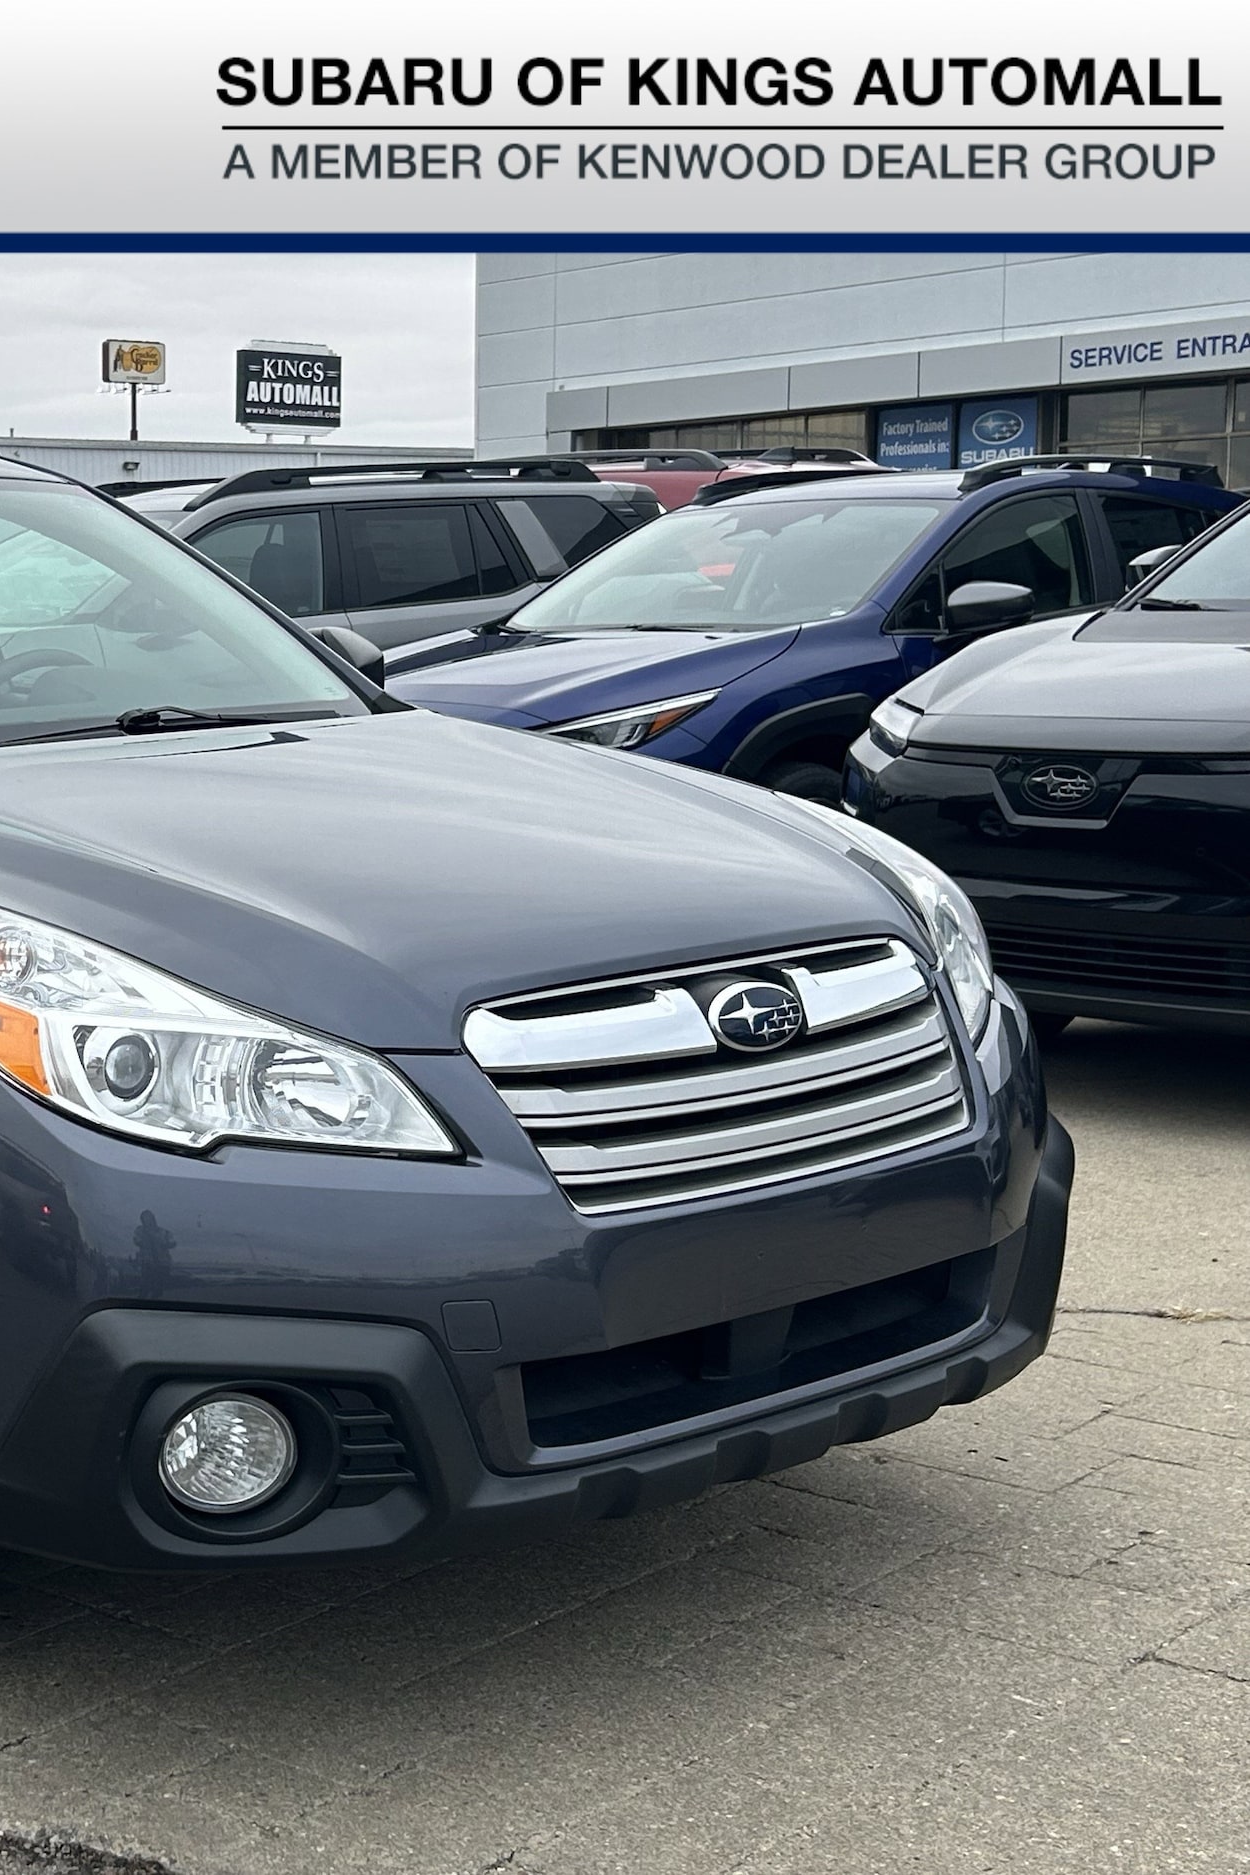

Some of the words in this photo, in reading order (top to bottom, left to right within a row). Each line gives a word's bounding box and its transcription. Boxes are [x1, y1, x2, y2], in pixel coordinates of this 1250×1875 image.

[1069, 340, 1164, 369] SERVICE
[1176, 331, 1250, 360] ENTRA
[262, 358, 325, 382] KINGS
[246, 380, 340, 407] AUTOMALL
[883, 422, 914, 437] Factory
[915, 417, 949, 434] Trained
[880, 439, 937, 457] Professionals
